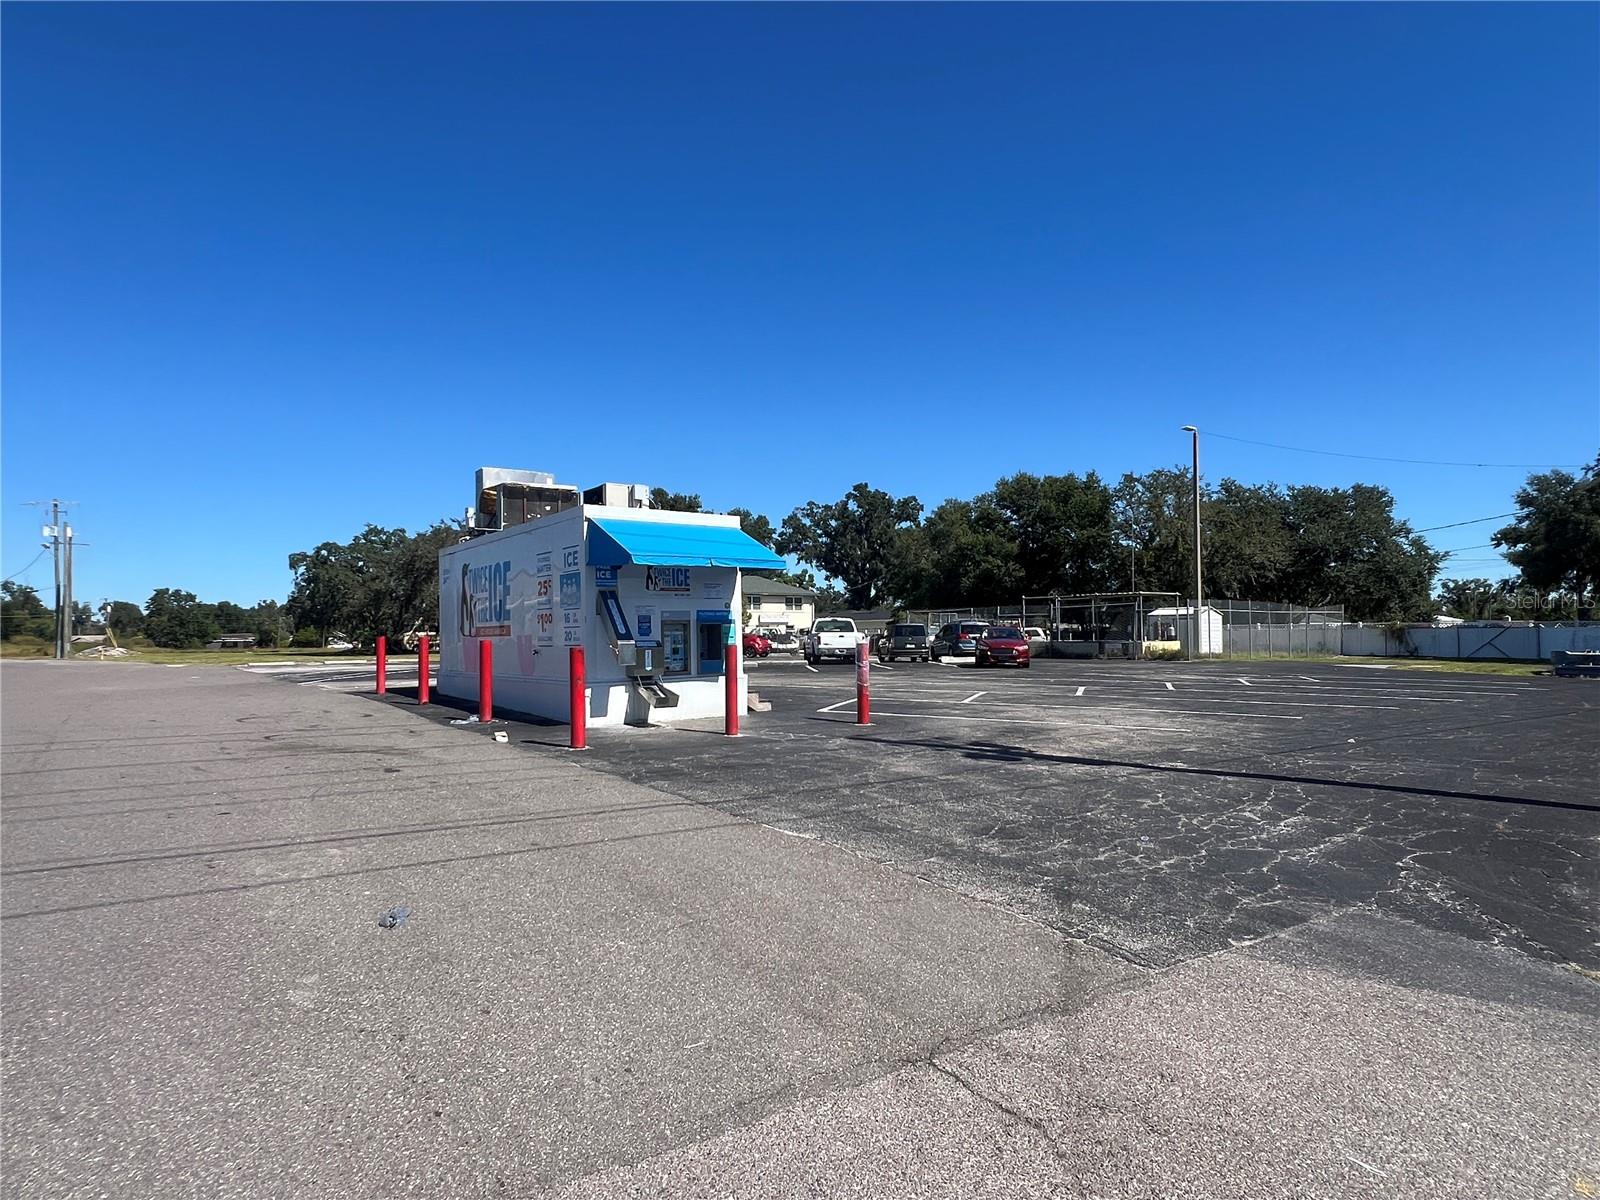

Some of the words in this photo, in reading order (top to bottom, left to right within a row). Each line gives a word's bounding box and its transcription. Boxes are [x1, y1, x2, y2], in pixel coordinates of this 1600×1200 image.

[563, 550, 578, 568] ICE
[597, 570, 612, 579] ICE
[672, 567, 690, 587] ICE
[488, 560, 511, 622] ICE
[564, 630, 573, 642] 20
